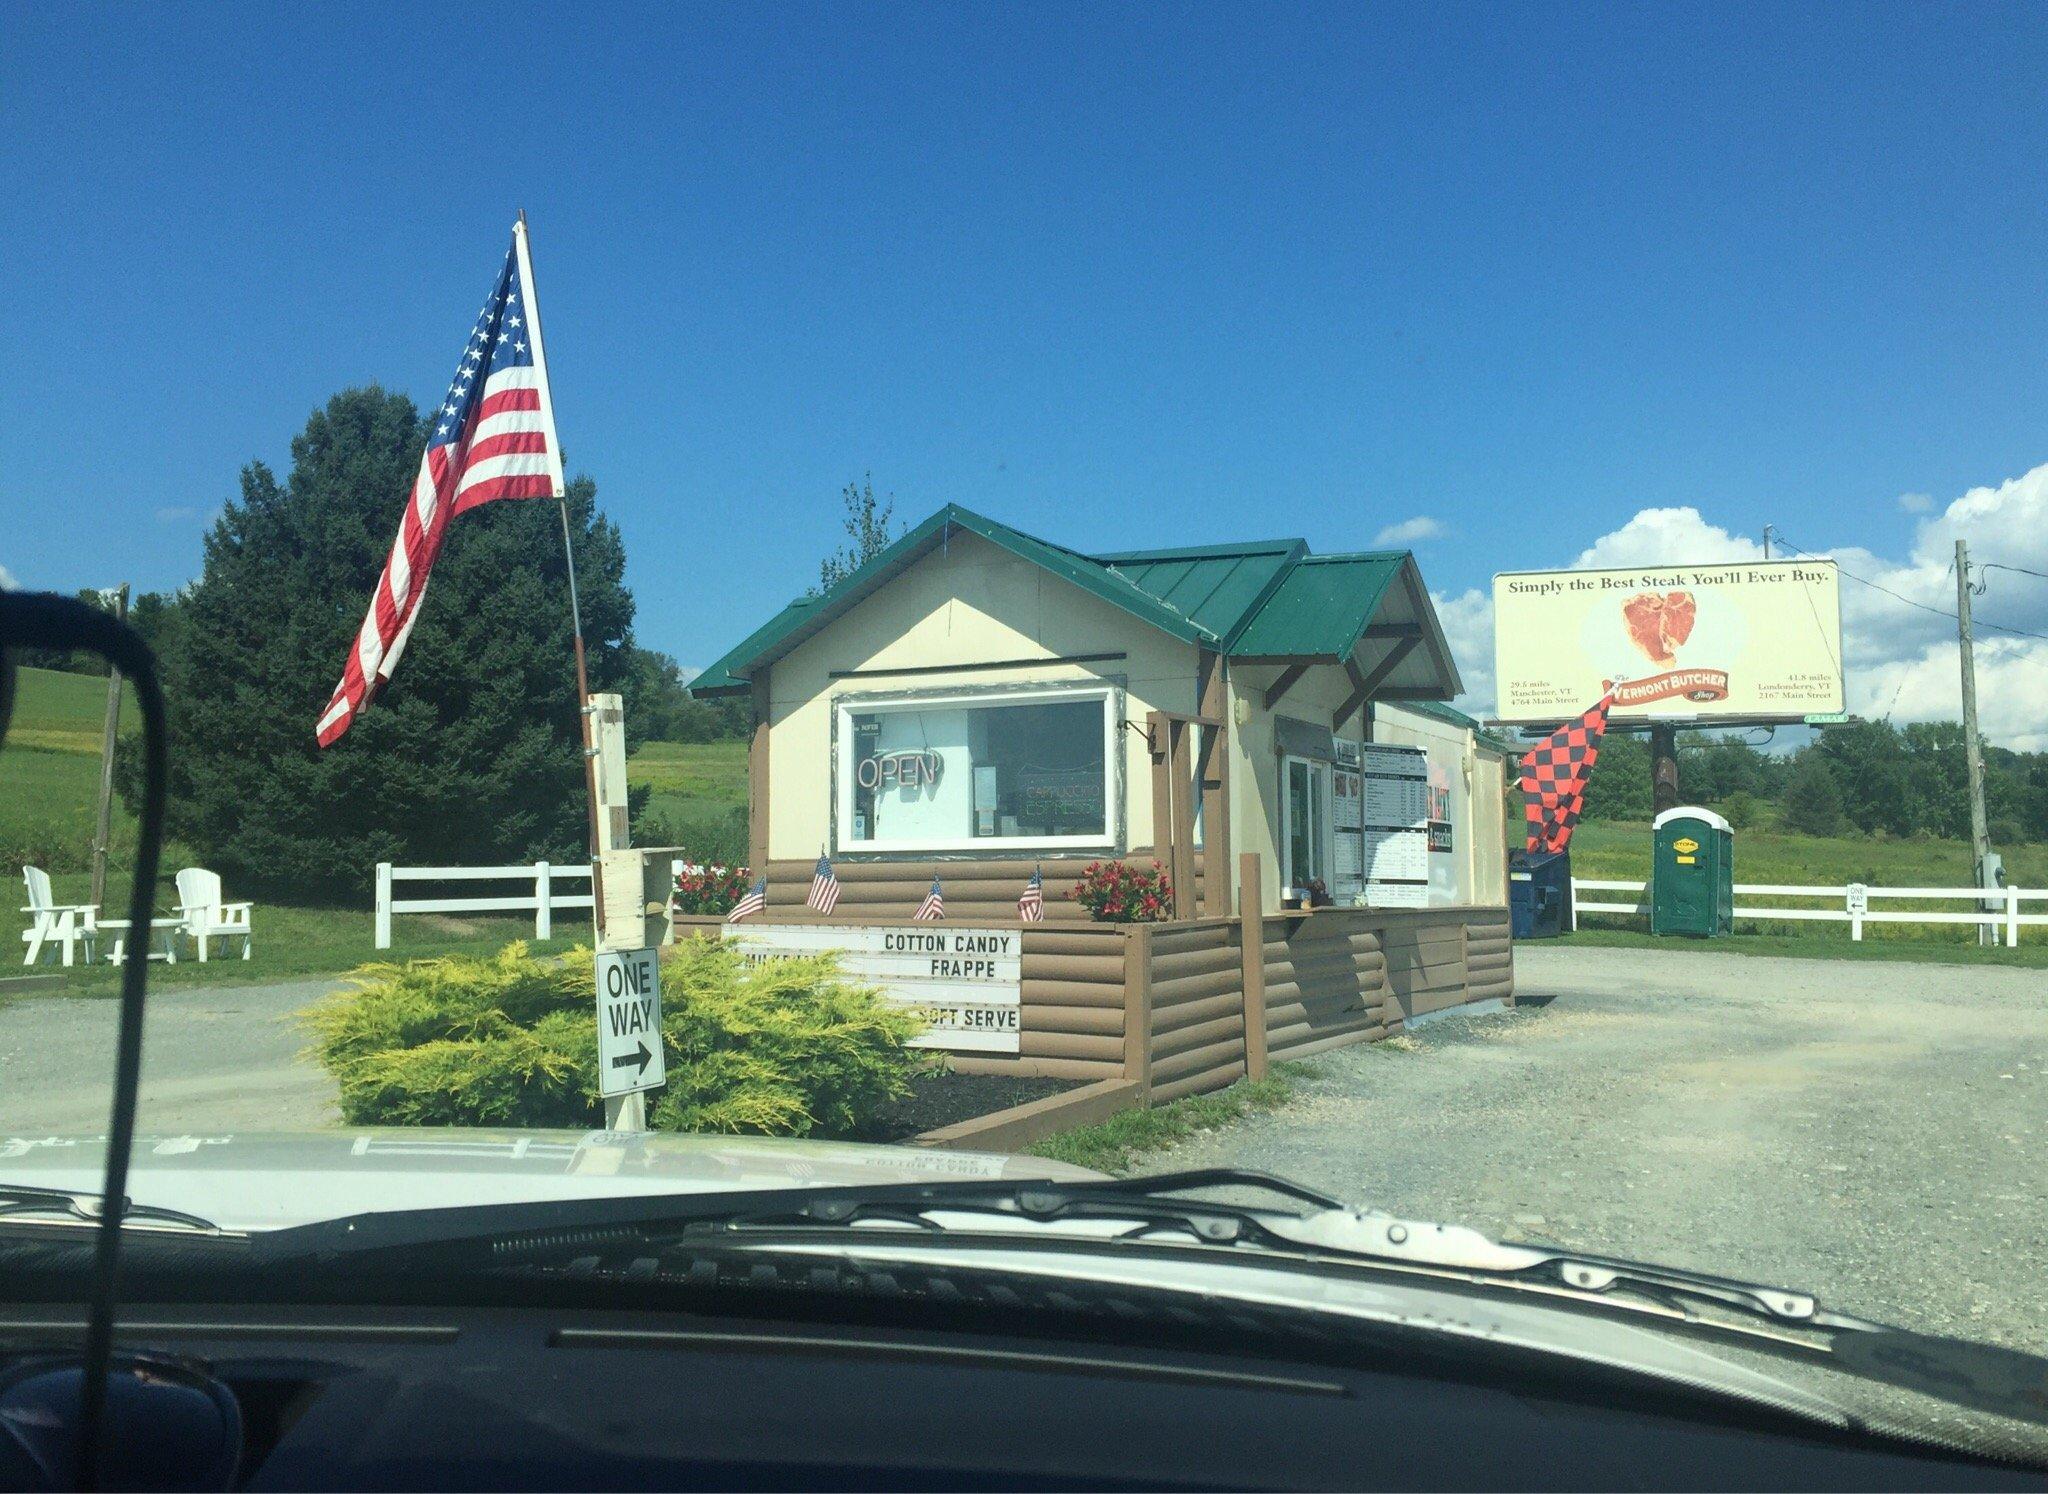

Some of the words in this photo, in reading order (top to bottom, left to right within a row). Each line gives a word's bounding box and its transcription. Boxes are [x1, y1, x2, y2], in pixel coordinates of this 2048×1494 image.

[1508, 581, 1564, 595] Simply
[1569, 579, 1595, 590] the
[1601, 577, 1635, 589] Best
[1641, 574, 1686, 587] Steak
[1747, 571, 1786, 583] Ever
[1792, 569, 1829, 584] Buy.
[1529, 680, 1551, 688] miles
[1670, 673, 1727, 690] BUTCHER
[1809, 673, 1832, 681] miles
[1693, 691, 1715, 701] Shop
[1758, 683, 1816, 692] Londonderry,
[1782, 691, 1805, 699] Main
[1806, 691, 1832, 699] Street
[858, 755, 936, 788] OPEN
[885, 934, 945, 951] COTTON
[955, 936, 1010, 953] CANDY
[931, 959, 995, 977] FRAPPE
[607, 961, 651, 998] ONE
[608, 998, 652, 1037] WAY
[964, 1010, 1016, 1027] SERVE
